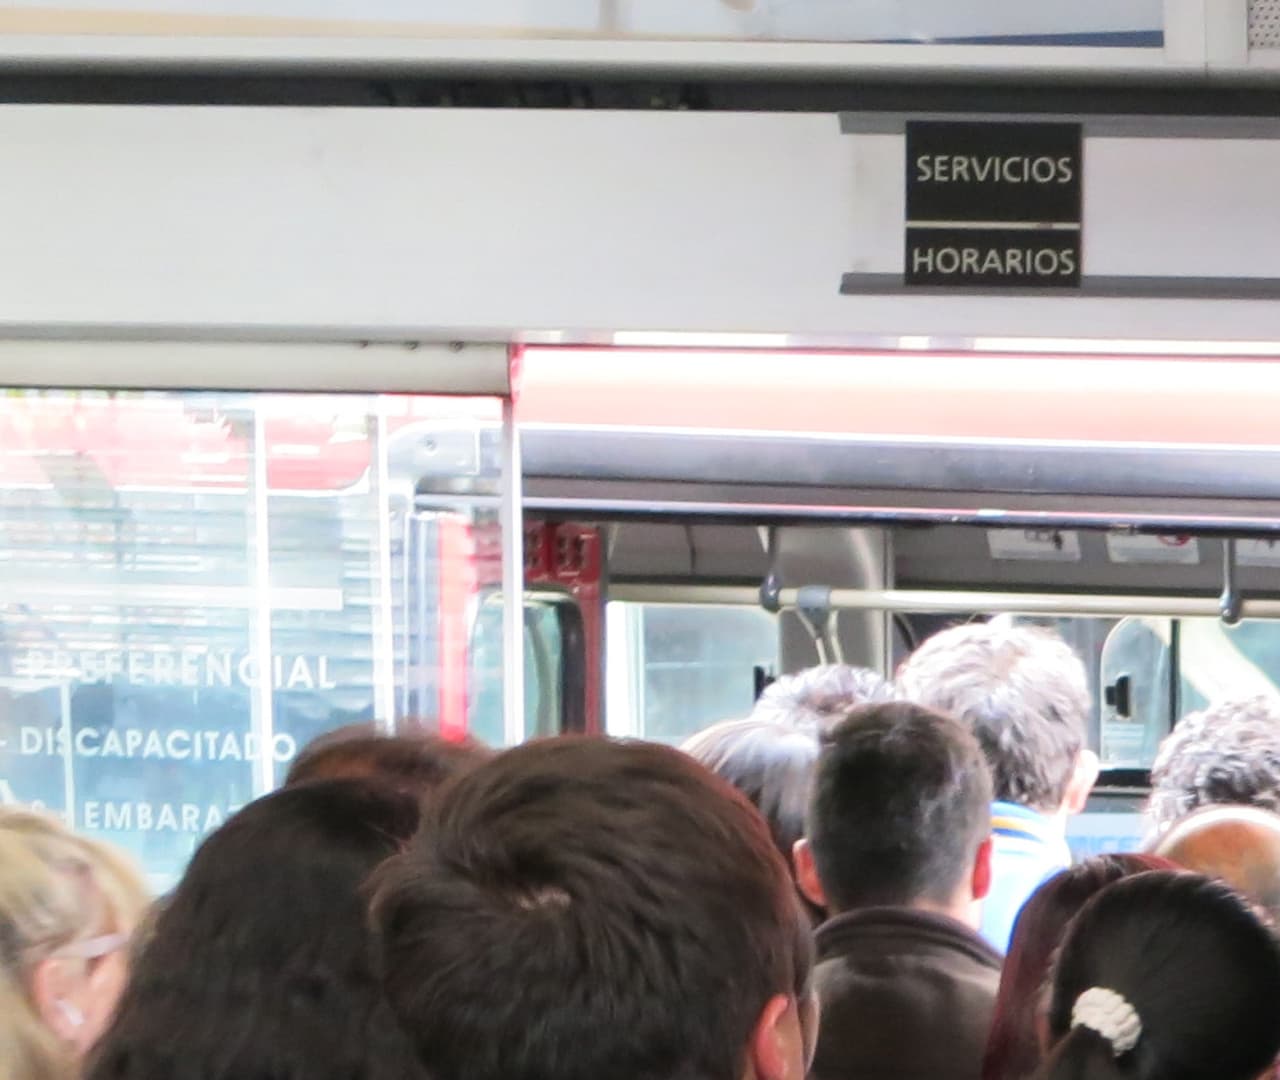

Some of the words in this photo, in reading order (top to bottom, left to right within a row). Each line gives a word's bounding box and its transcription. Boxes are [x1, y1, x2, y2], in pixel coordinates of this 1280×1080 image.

[916, 155, 1073, 183] SERVICIOS
[913, 248, 1075, 275] HORARIOS
[27, 649, 336, 690] PREFERENCIAL
[20, 726, 297, 763] DISCAPACITADO
[84, 801, 240, 835] EMBARA
